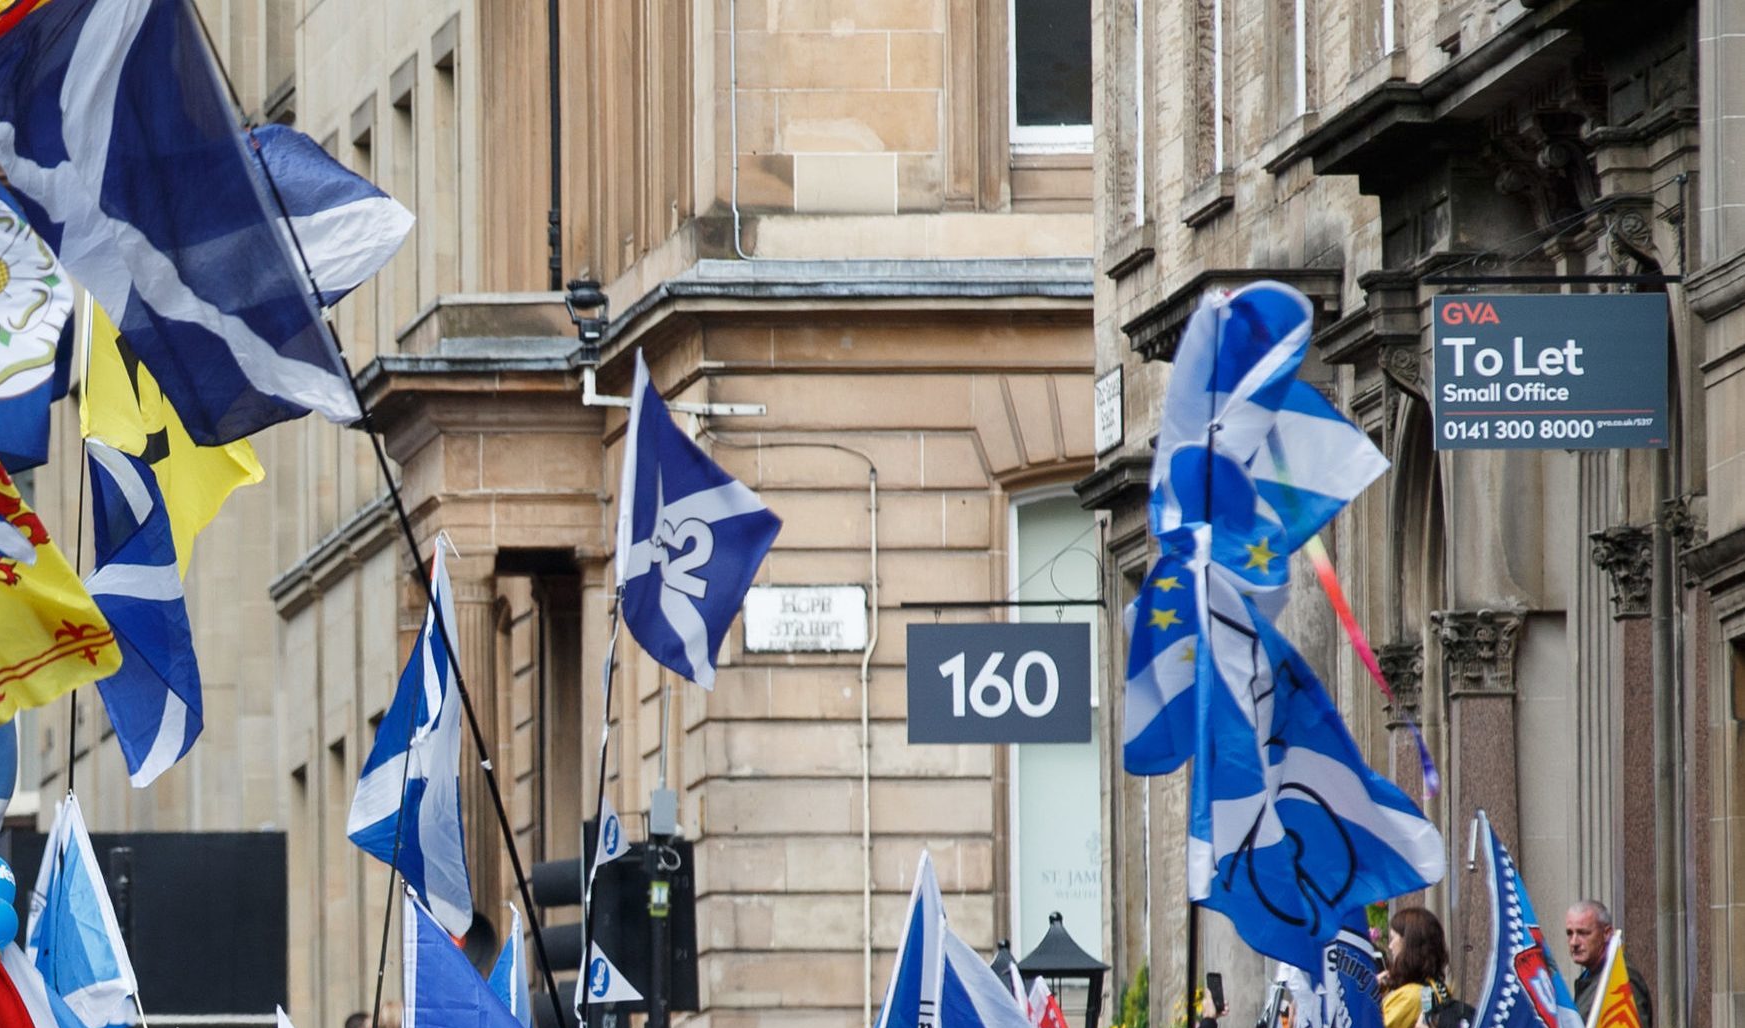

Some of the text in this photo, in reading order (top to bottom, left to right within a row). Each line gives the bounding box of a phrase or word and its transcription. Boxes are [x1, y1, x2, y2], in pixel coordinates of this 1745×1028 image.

[1441, 301, 1501, 326] GVA
[1441, 336, 1585, 377] To Let
[1442, 382, 1570, 403] Small Office
[1443, 420, 1489, 440] 0141
[1494, 419, 1535, 440] 300
[1539, 418, 1594, 440] 8000
[938, 649, 1061, 719] 160
[592, 960, 607, 993] Yes
